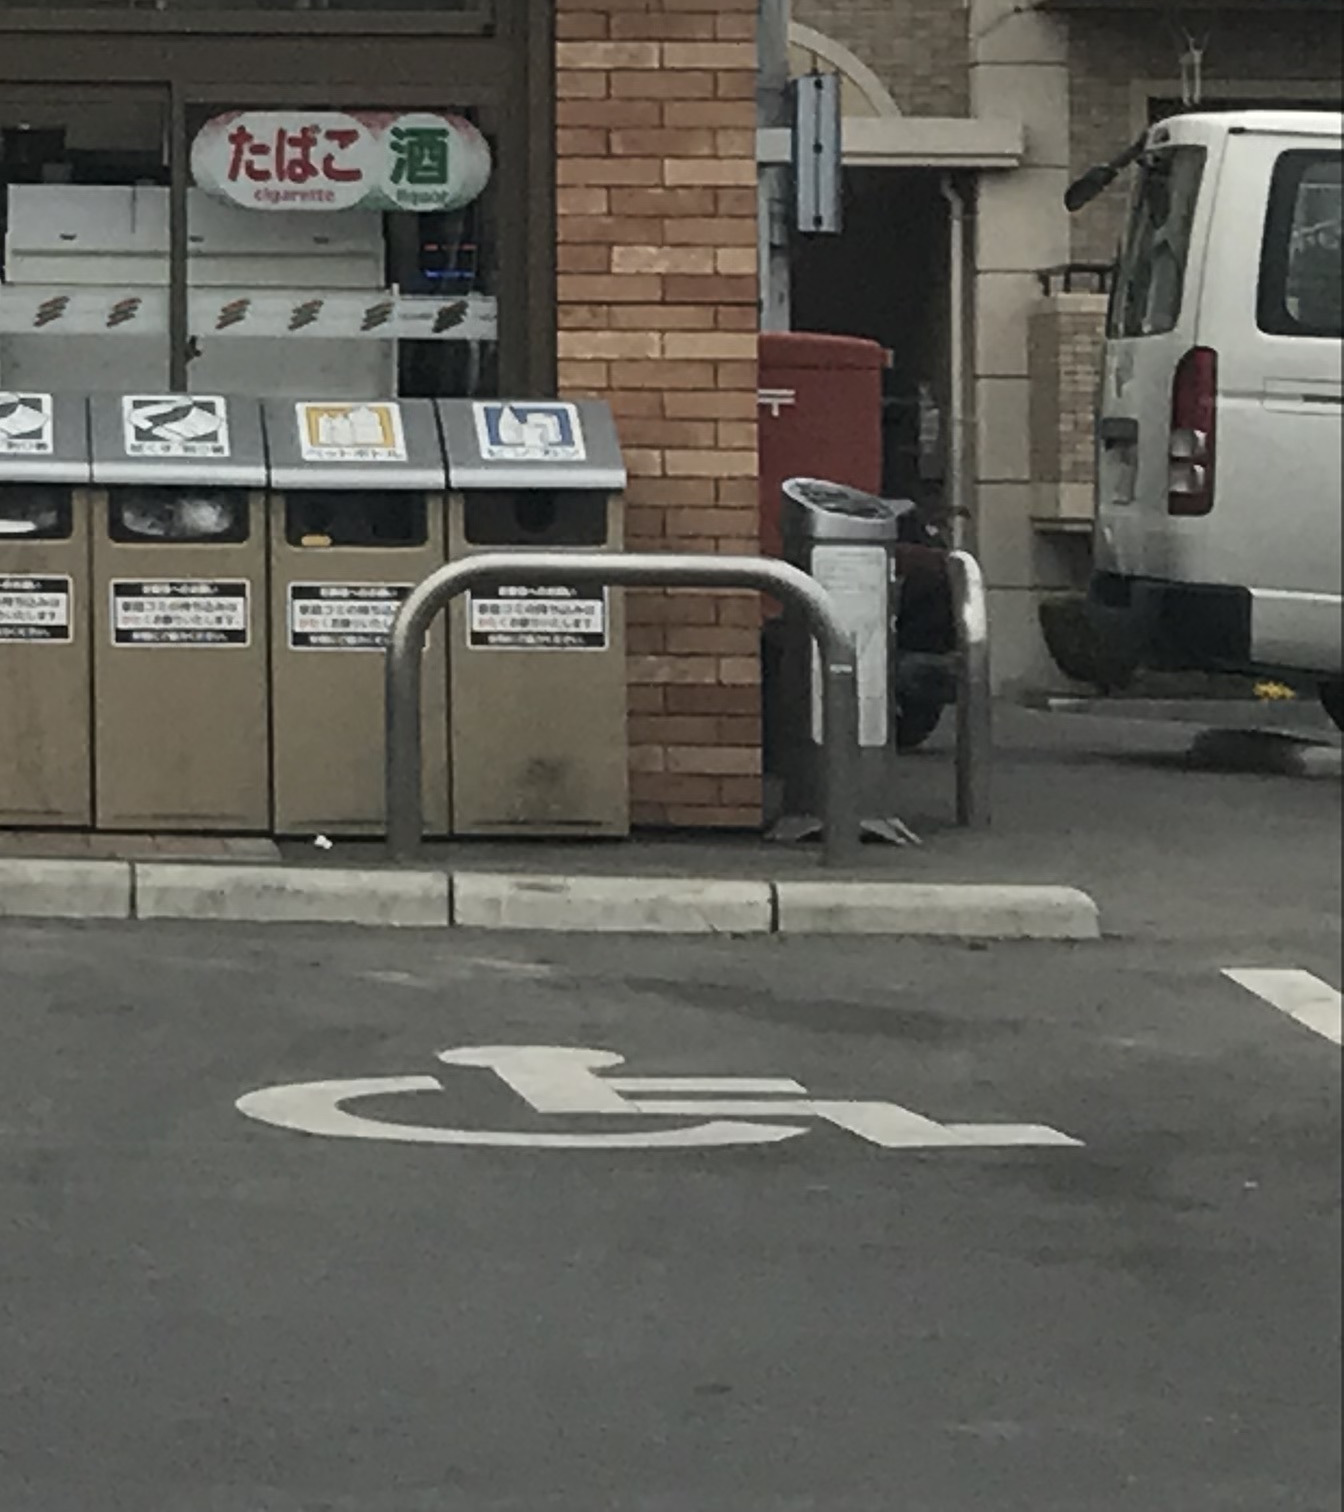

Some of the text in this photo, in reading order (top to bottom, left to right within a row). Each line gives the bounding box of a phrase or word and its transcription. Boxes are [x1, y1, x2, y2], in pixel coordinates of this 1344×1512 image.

[228, 124, 363, 183] たばこ
[390, 126, 450, 185] 酒
[254, 188, 335, 203] cigarette
